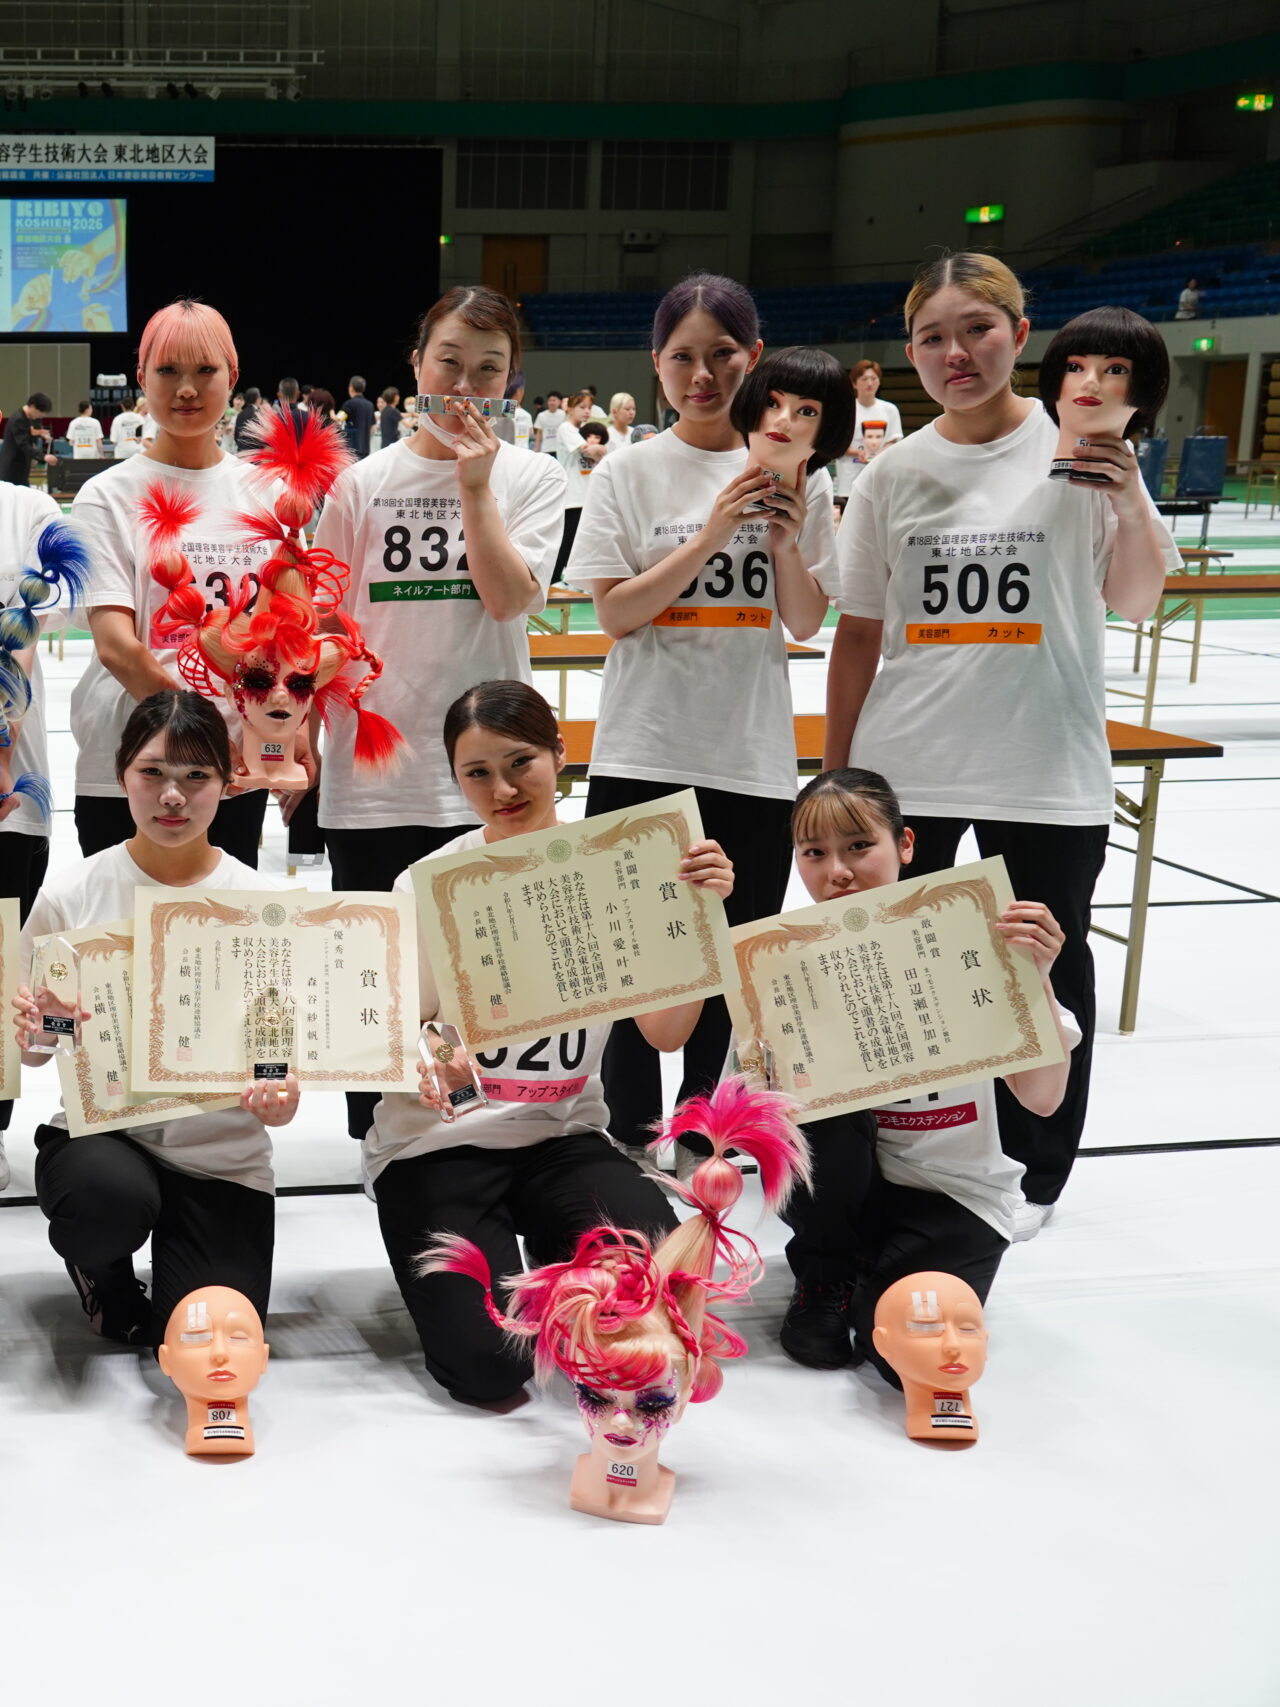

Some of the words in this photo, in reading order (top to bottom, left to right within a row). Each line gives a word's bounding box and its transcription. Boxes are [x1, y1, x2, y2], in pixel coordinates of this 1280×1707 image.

[113, 143, 208, 164] 東北地区大会
[16, 218, 71, 228] KOSHIEN
[17, 201, 104, 217] RIBIYO
[907, 531, 1046, 547] 第18回全国理容美容学生技術大会
[931, 545, 1018, 558] 東北地区大会
[185, 555, 252, 566] 北地区大会
[392, 584, 471, 596] ネイルアート部門
[922, 562, 1030, 615] 506
[669, 612, 698, 621] 美容部門
[736, 611, 767, 622] カット
[918, 629, 950, 639] 美容部門
[987, 627, 1025, 638] カット
[264, 743, 282, 753] 632
[623, 850, 640, 890] 敢闘賞
[521, 884, 534, 907] ます
[659, 882, 687, 940] 賞状
[533, 881, 568, 1002] 収められたのでこれを賞し
[548, 877, 582, 999] 大会において頭書の成績を
[561, 873, 596, 996] 美容学生技術大会東北地区
[572, 871, 608, 992] あなたは第十八回全国理容
[921, 918, 941, 959] 敢闘賞
[232, 937, 241, 959] ます
[333, 930, 344, 968] 優秀賞
[817, 953, 831, 976] ます
[960, 949, 994, 1008] 賞状
[360, 969, 379, 1025] 賞状
[829, 950, 874, 1073] 収められたのでこれを賞し
[844, 946, 888, 1070] 大会において頭書の成績を
[857, 943, 902, 1067] 美容学生技術大会東北地区
[870, 940, 915, 1063] あなたは第十八回全国理容
[904, 968, 941, 1057] 田辺瀬里加殿
[211, 1410, 232, 1420] 708
[940, 1401, 960, 1412] 727
[611, 1463, 634, 1476] 620
